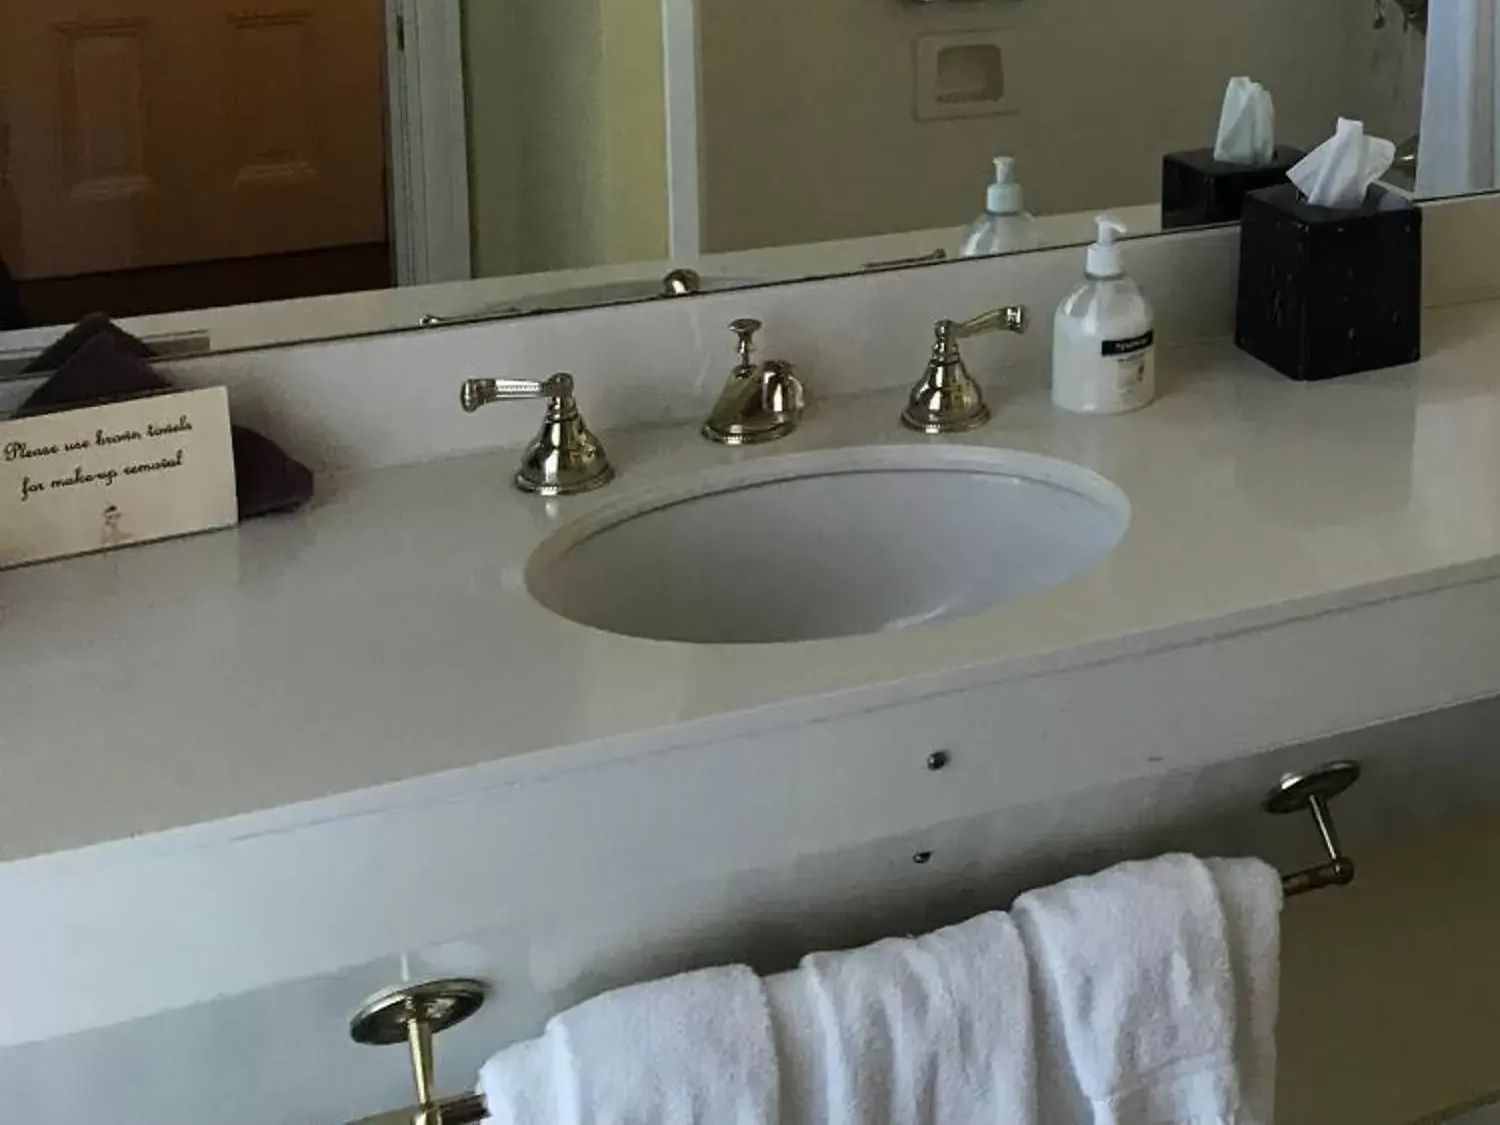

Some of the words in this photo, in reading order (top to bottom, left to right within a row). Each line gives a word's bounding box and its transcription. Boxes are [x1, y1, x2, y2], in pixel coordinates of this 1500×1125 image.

[3, 442, 59, 461] Please
[65, 440, 90, 452] use
[95, 429, 141, 446] brown
[147, 415, 192, 437] towels
[21, 477, 45, 501] for
[123, 449, 183, 475] removal
